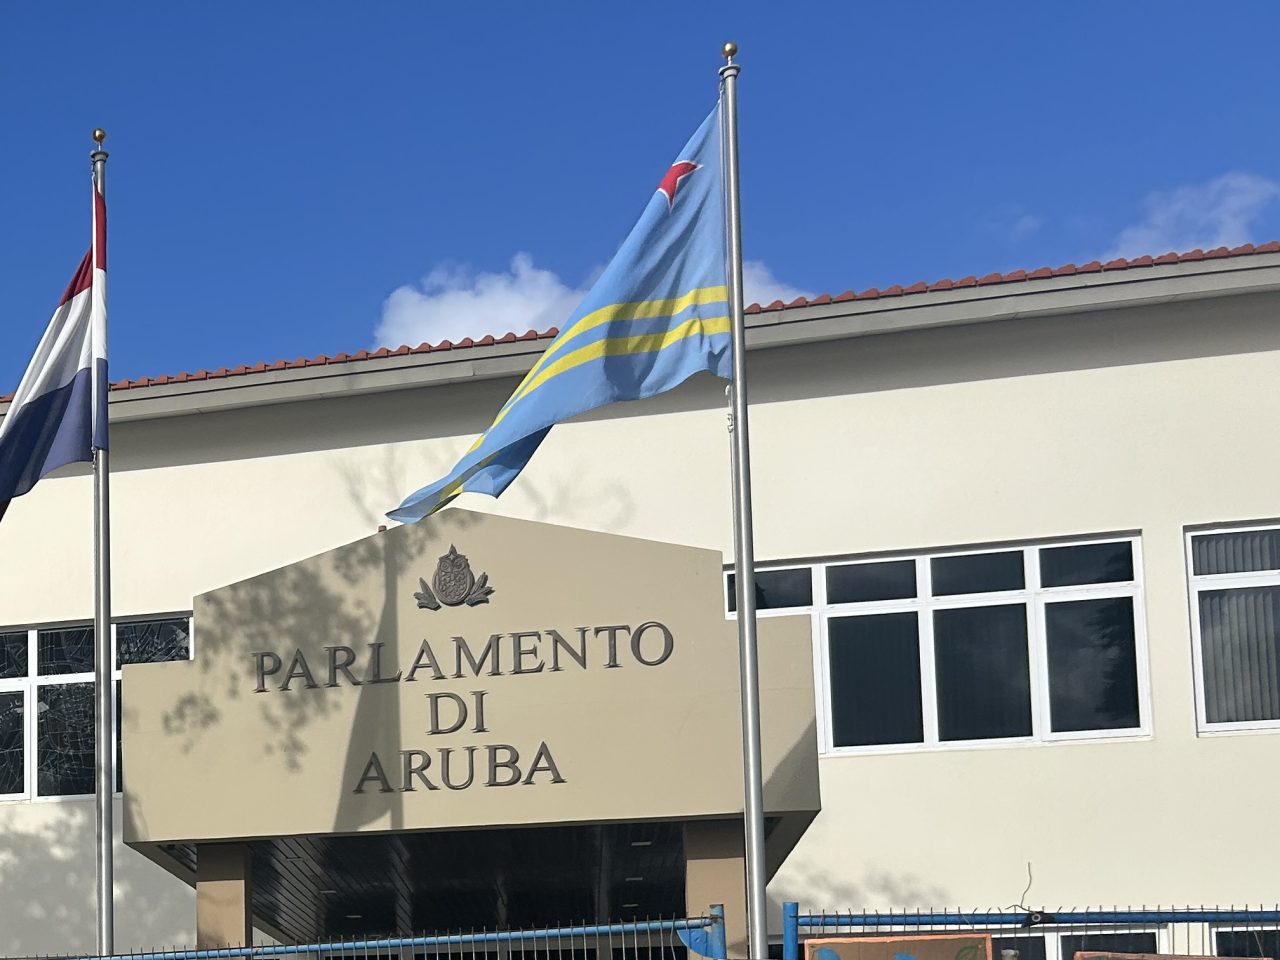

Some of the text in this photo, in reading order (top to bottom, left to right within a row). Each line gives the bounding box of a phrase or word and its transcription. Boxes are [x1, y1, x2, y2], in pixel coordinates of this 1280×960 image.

[251, 621, 674, 693] PARLAMENTO
[425, 690, 490, 735] DI
[352, 742, 567, 793] ARUBA
